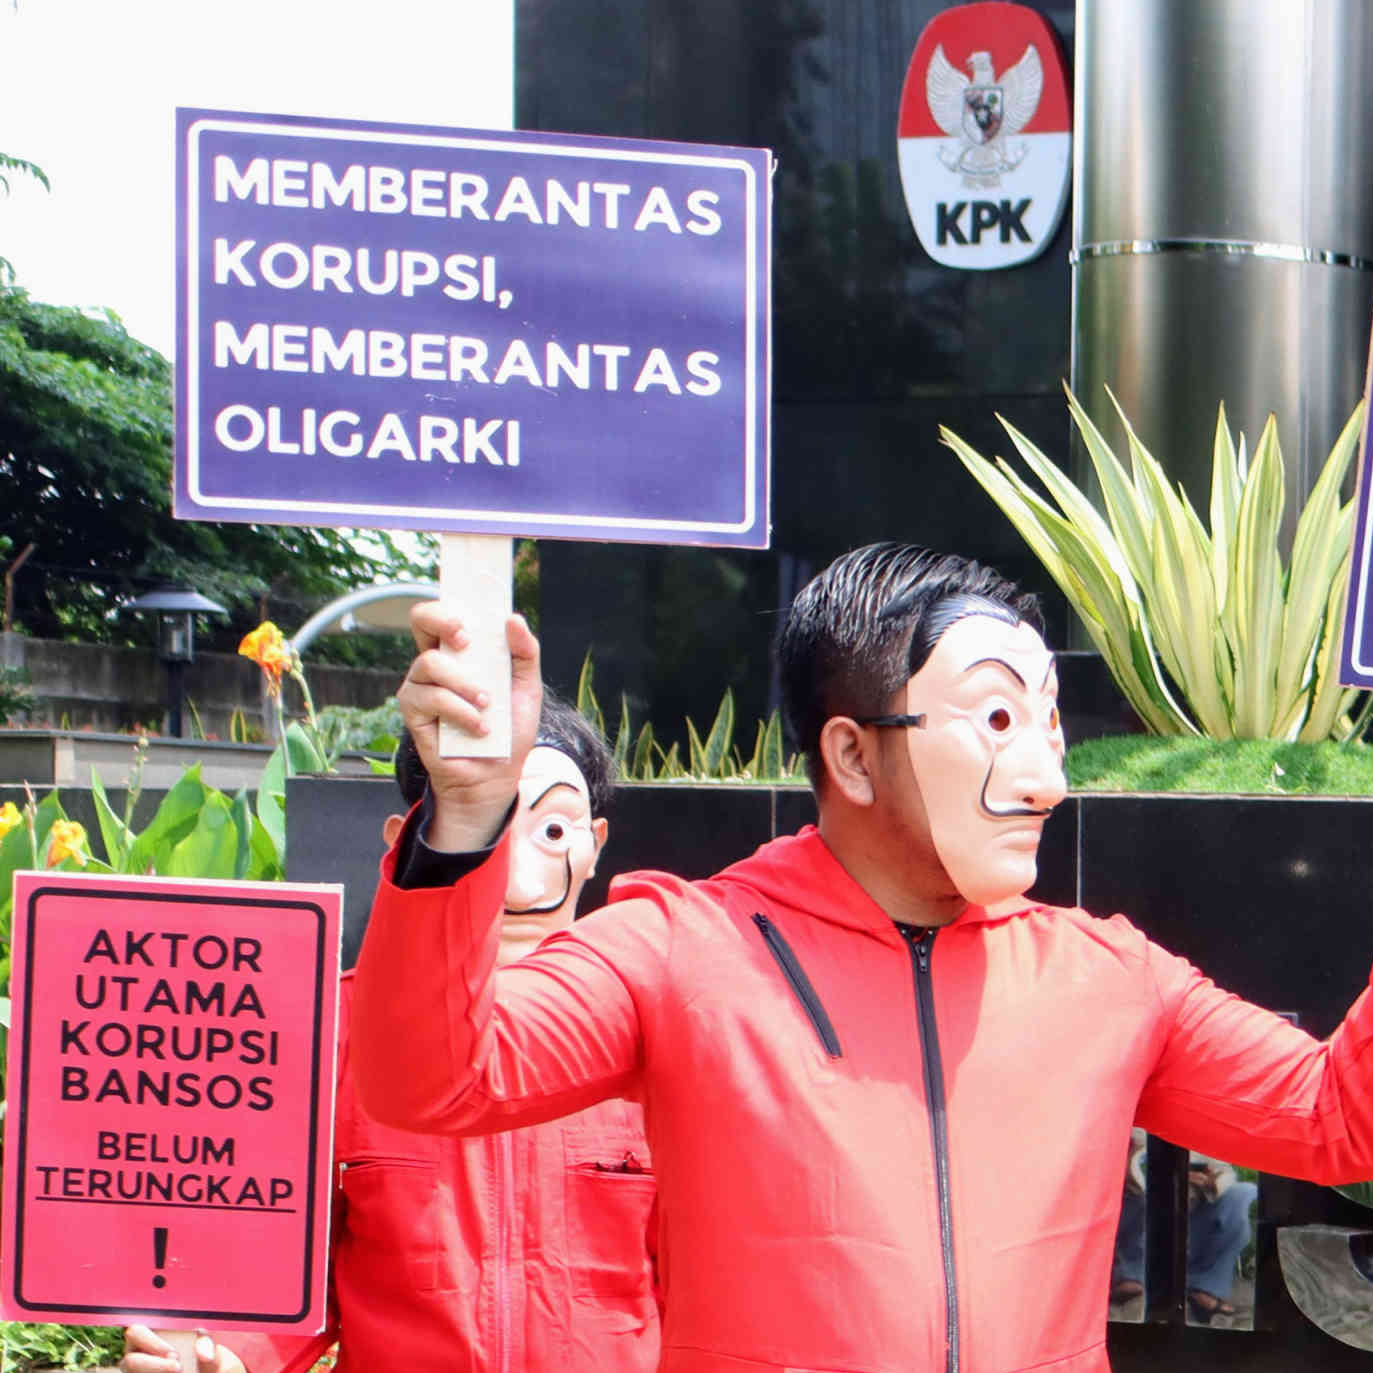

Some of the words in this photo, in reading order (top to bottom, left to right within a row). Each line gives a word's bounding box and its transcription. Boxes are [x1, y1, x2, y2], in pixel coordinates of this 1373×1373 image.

[214, 154, 723, 237] MEMBERANTAS
[936, 198, 1033, 246] KPK
[214, 237, 513, 309] KORUPSI,
[214, 320, 723, 397] MEMBERANTAS
[215, 404, 520, 467] OLIGARKI
[83, 929, 262, 973] AKTOR
[76, 974, 266, 1019] UTAMA
[60, 1019, 278, 1066] KORUPSI
[61, 1066, 274, 1112] BANSOS
[97, 1131, 235, 1166] BELUM
[38, 1166, 293, 1206] TERUNGKAP
[152, 1227, 169, 1289] !
